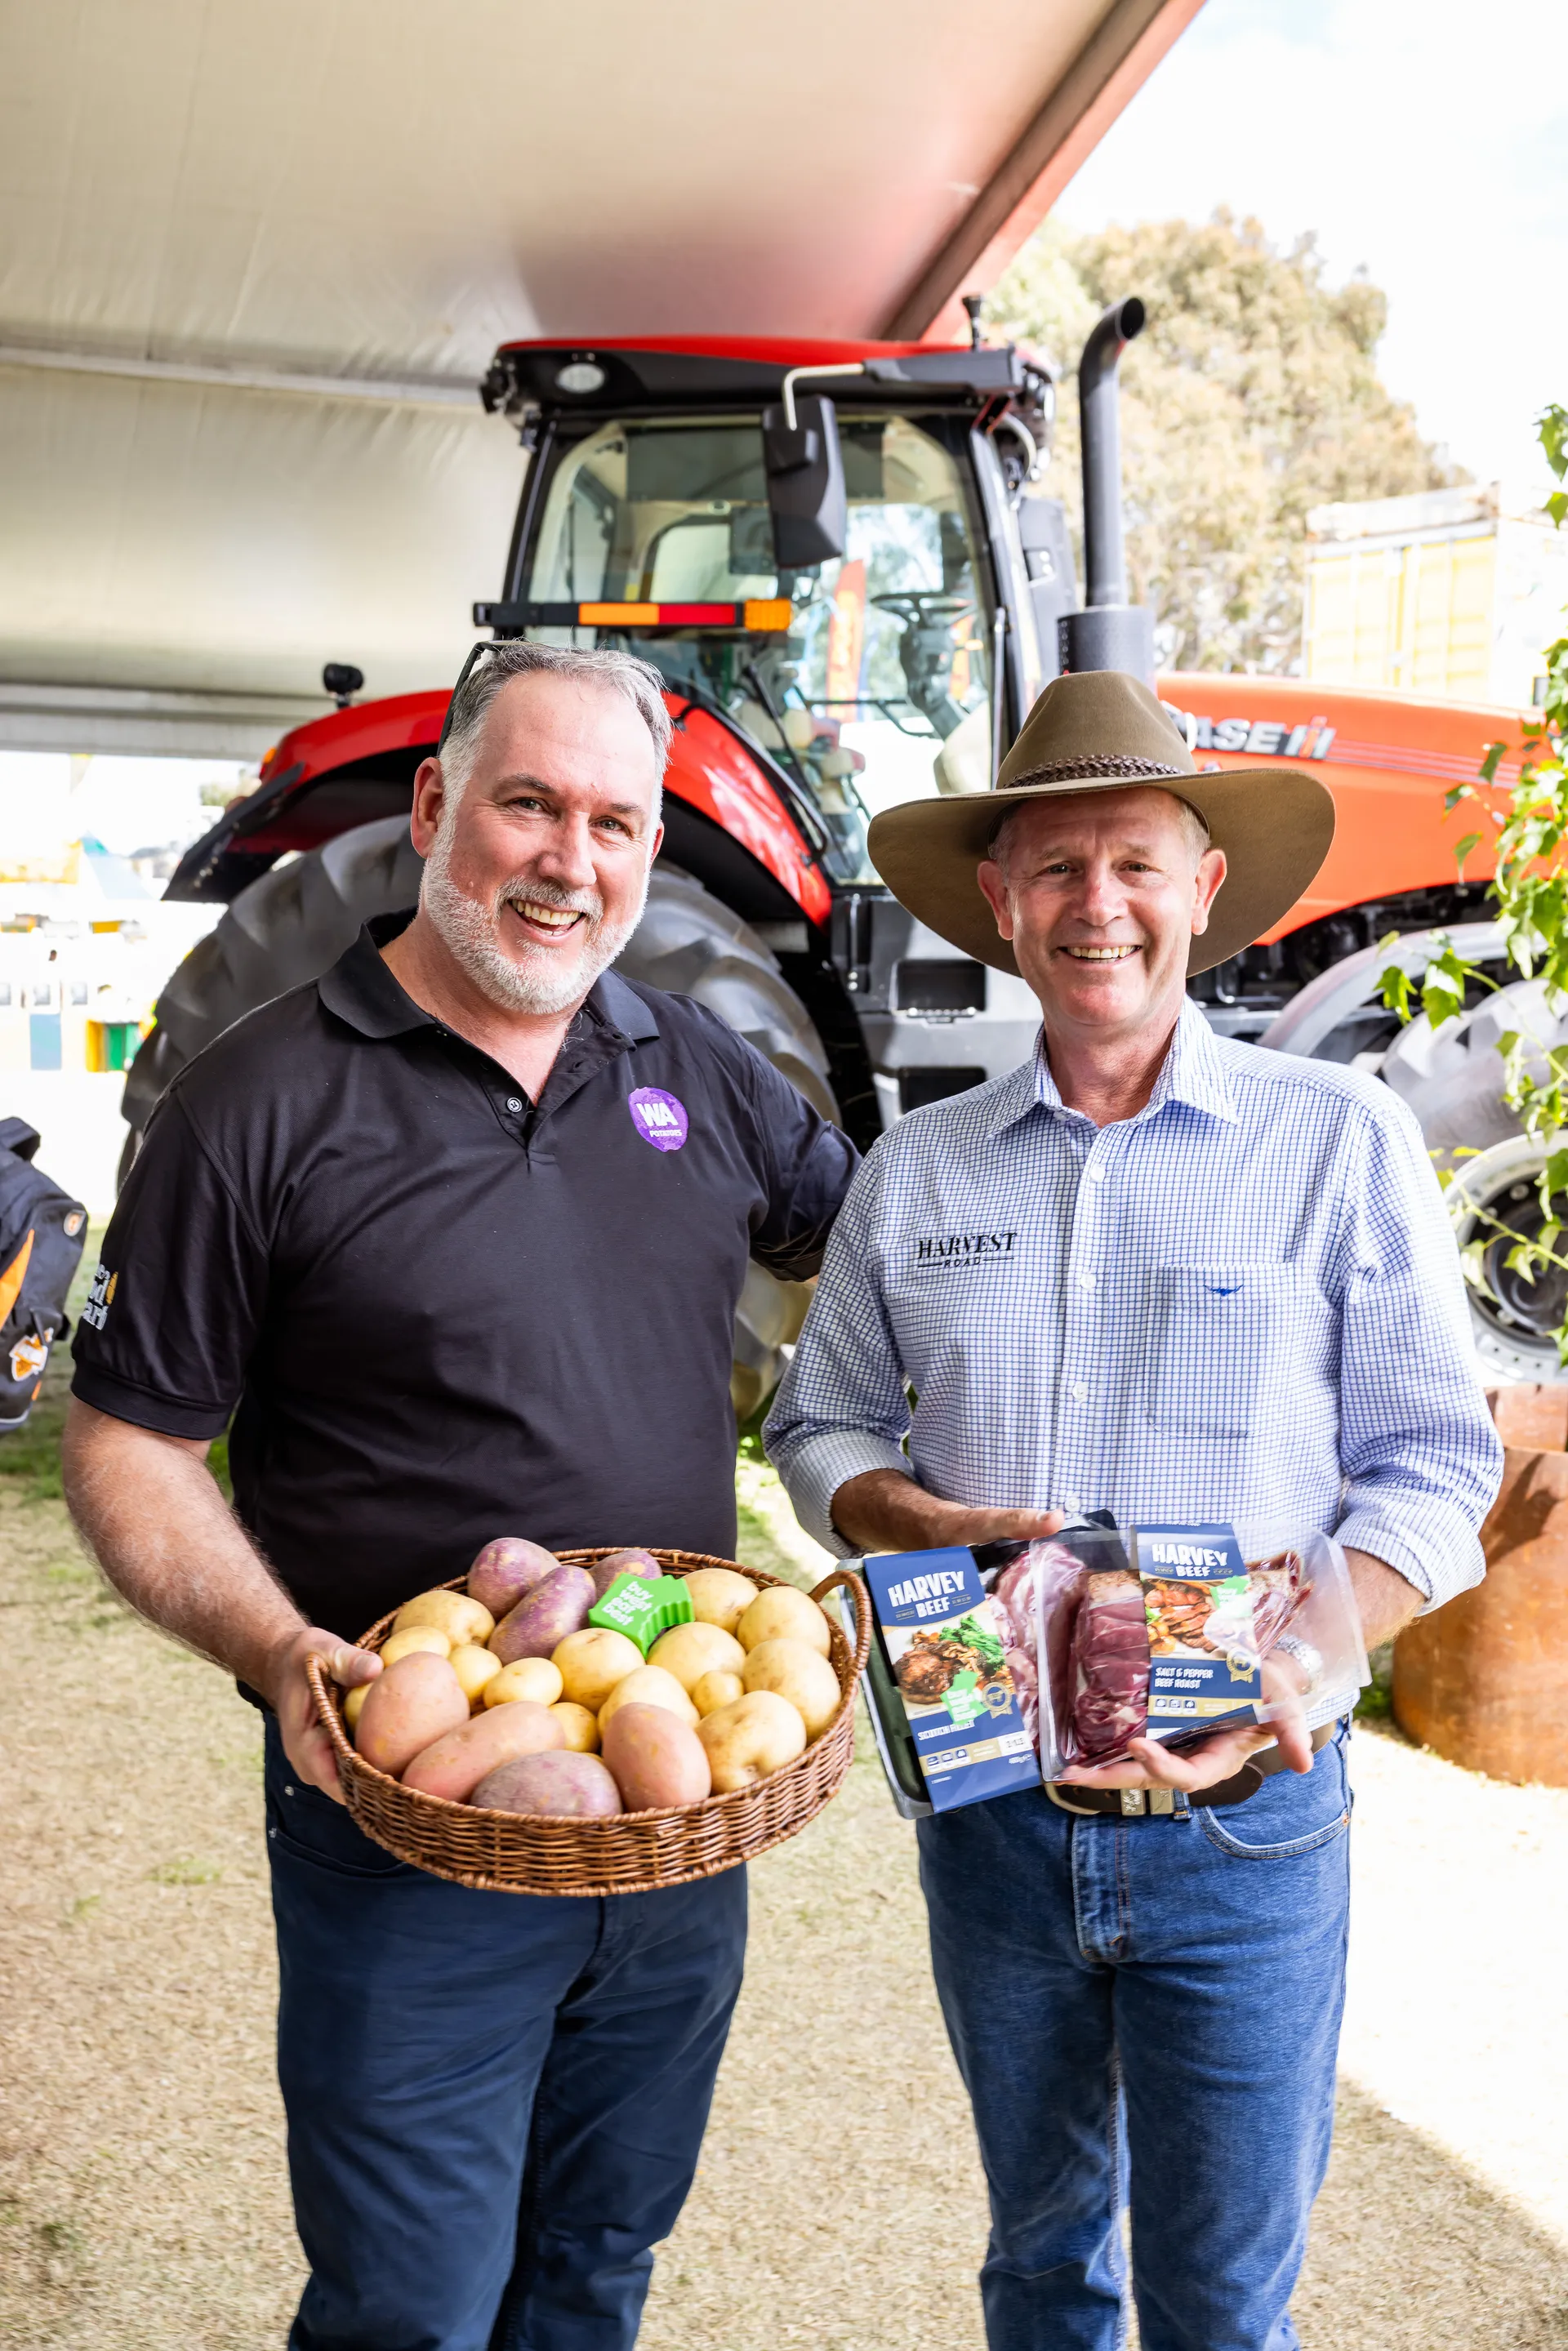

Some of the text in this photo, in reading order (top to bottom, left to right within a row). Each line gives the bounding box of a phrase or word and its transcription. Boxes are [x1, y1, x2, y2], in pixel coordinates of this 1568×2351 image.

[636, 1102, 679, 1126] WA
[917, 1232, 1018, 1258] HARVEST
[944, 1257, 981, 1267] ROAD
[1152, 1543, 1227, 1566] HARVEY
[1176, 1565, 1211, 1577] BEEF
[888, 1571, 965, 1607] HARVEY
[915, 1596, 951, 1618] BEEF
[1155, 1667, 1214, 1679] SALT & PEPPER
[1155, 1678, 1201, 1689] BEEF ROAST
